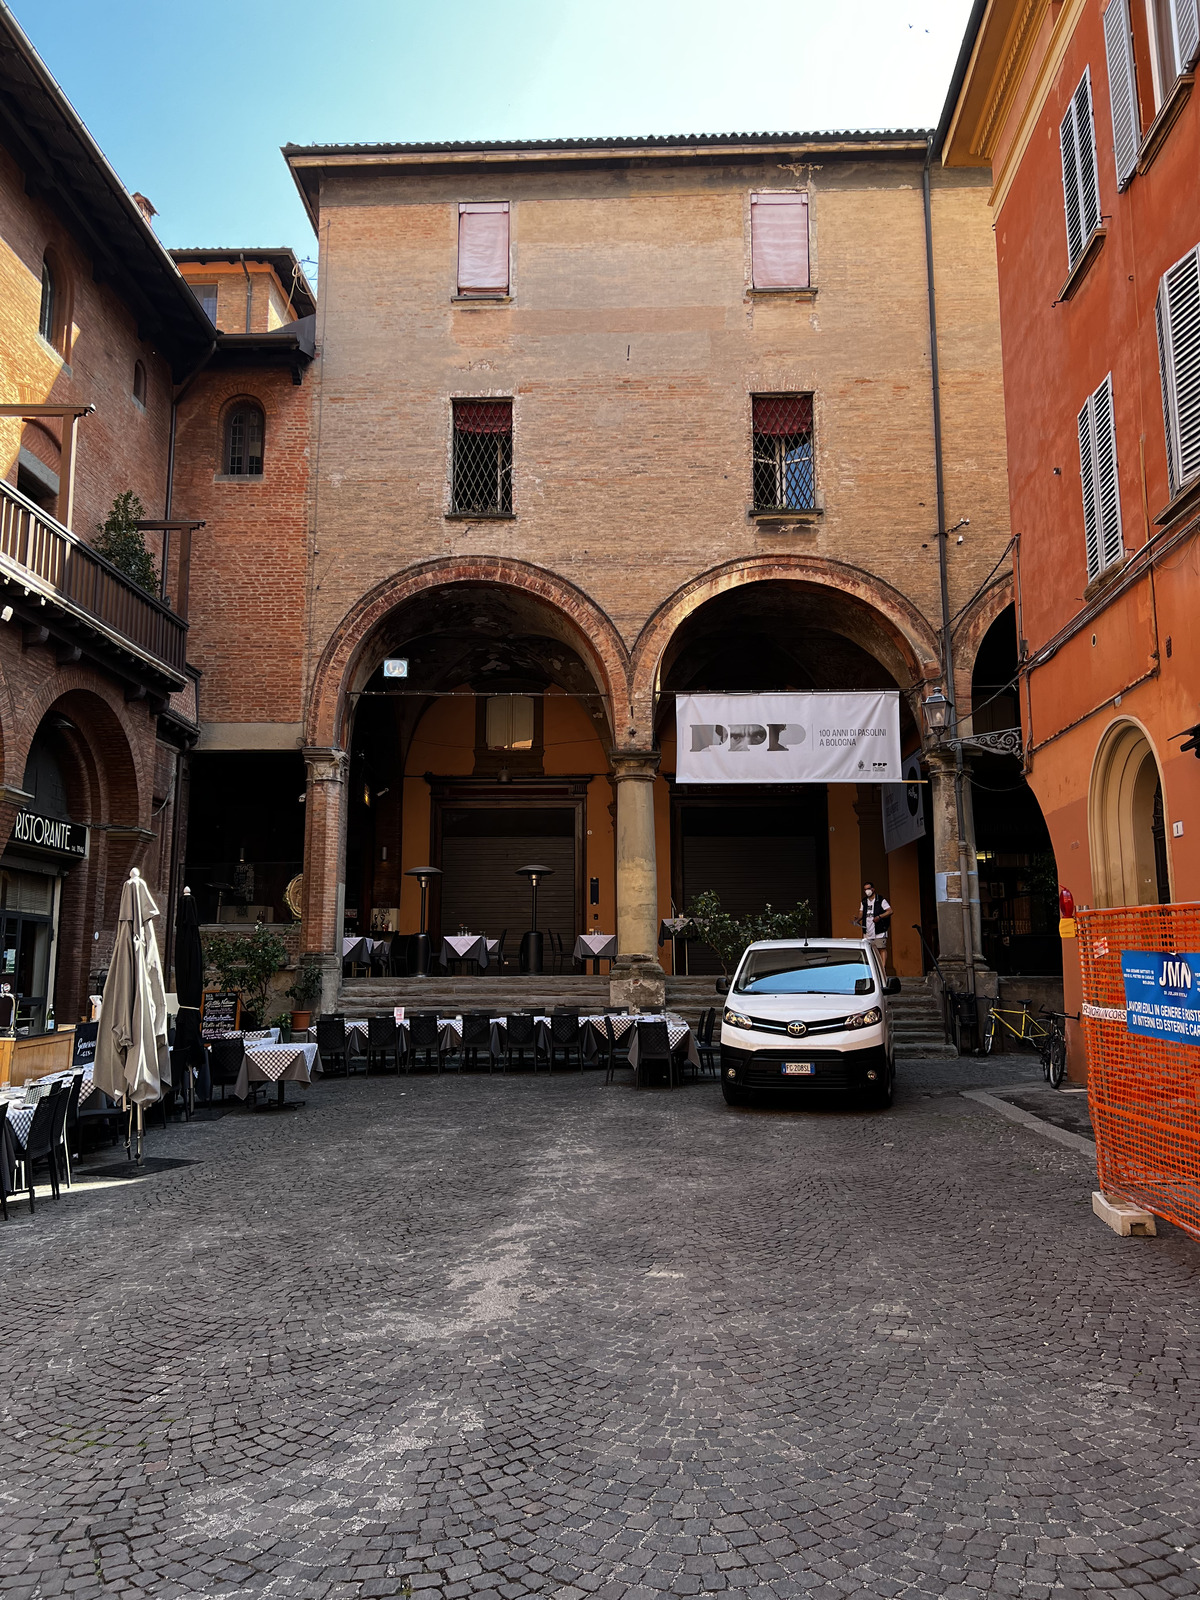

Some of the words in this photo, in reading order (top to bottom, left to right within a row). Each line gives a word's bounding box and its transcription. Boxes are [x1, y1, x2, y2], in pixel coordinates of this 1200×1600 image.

[690, 724, 806, 752] PPP
[819, 729, 831, 737] 100
[832, 729, 849, 737] ANNI
[858, 728, 887, 736] PASOLINI
[15, 812, 72, 850] RISTORANTE
[1159, 961, 1191, 989] JMN
[1108, 1009, 1126, 1020] CORS
[1127, 1000, 1142, 1013] LAVORI
[1142, 1002, 1154, 1015] EDILI
[1154, 1004, 1160, 1016] IN
[1160, 1005, 1182, 1019] GENERE
[1132, 1014, 1137, 1025] DI
[1138, 1015, 1156, 1029] INTERNI
[1156, 1018, 1164, 1030] ED
[1164, 1020, 1185, 1034] ESTERNI
